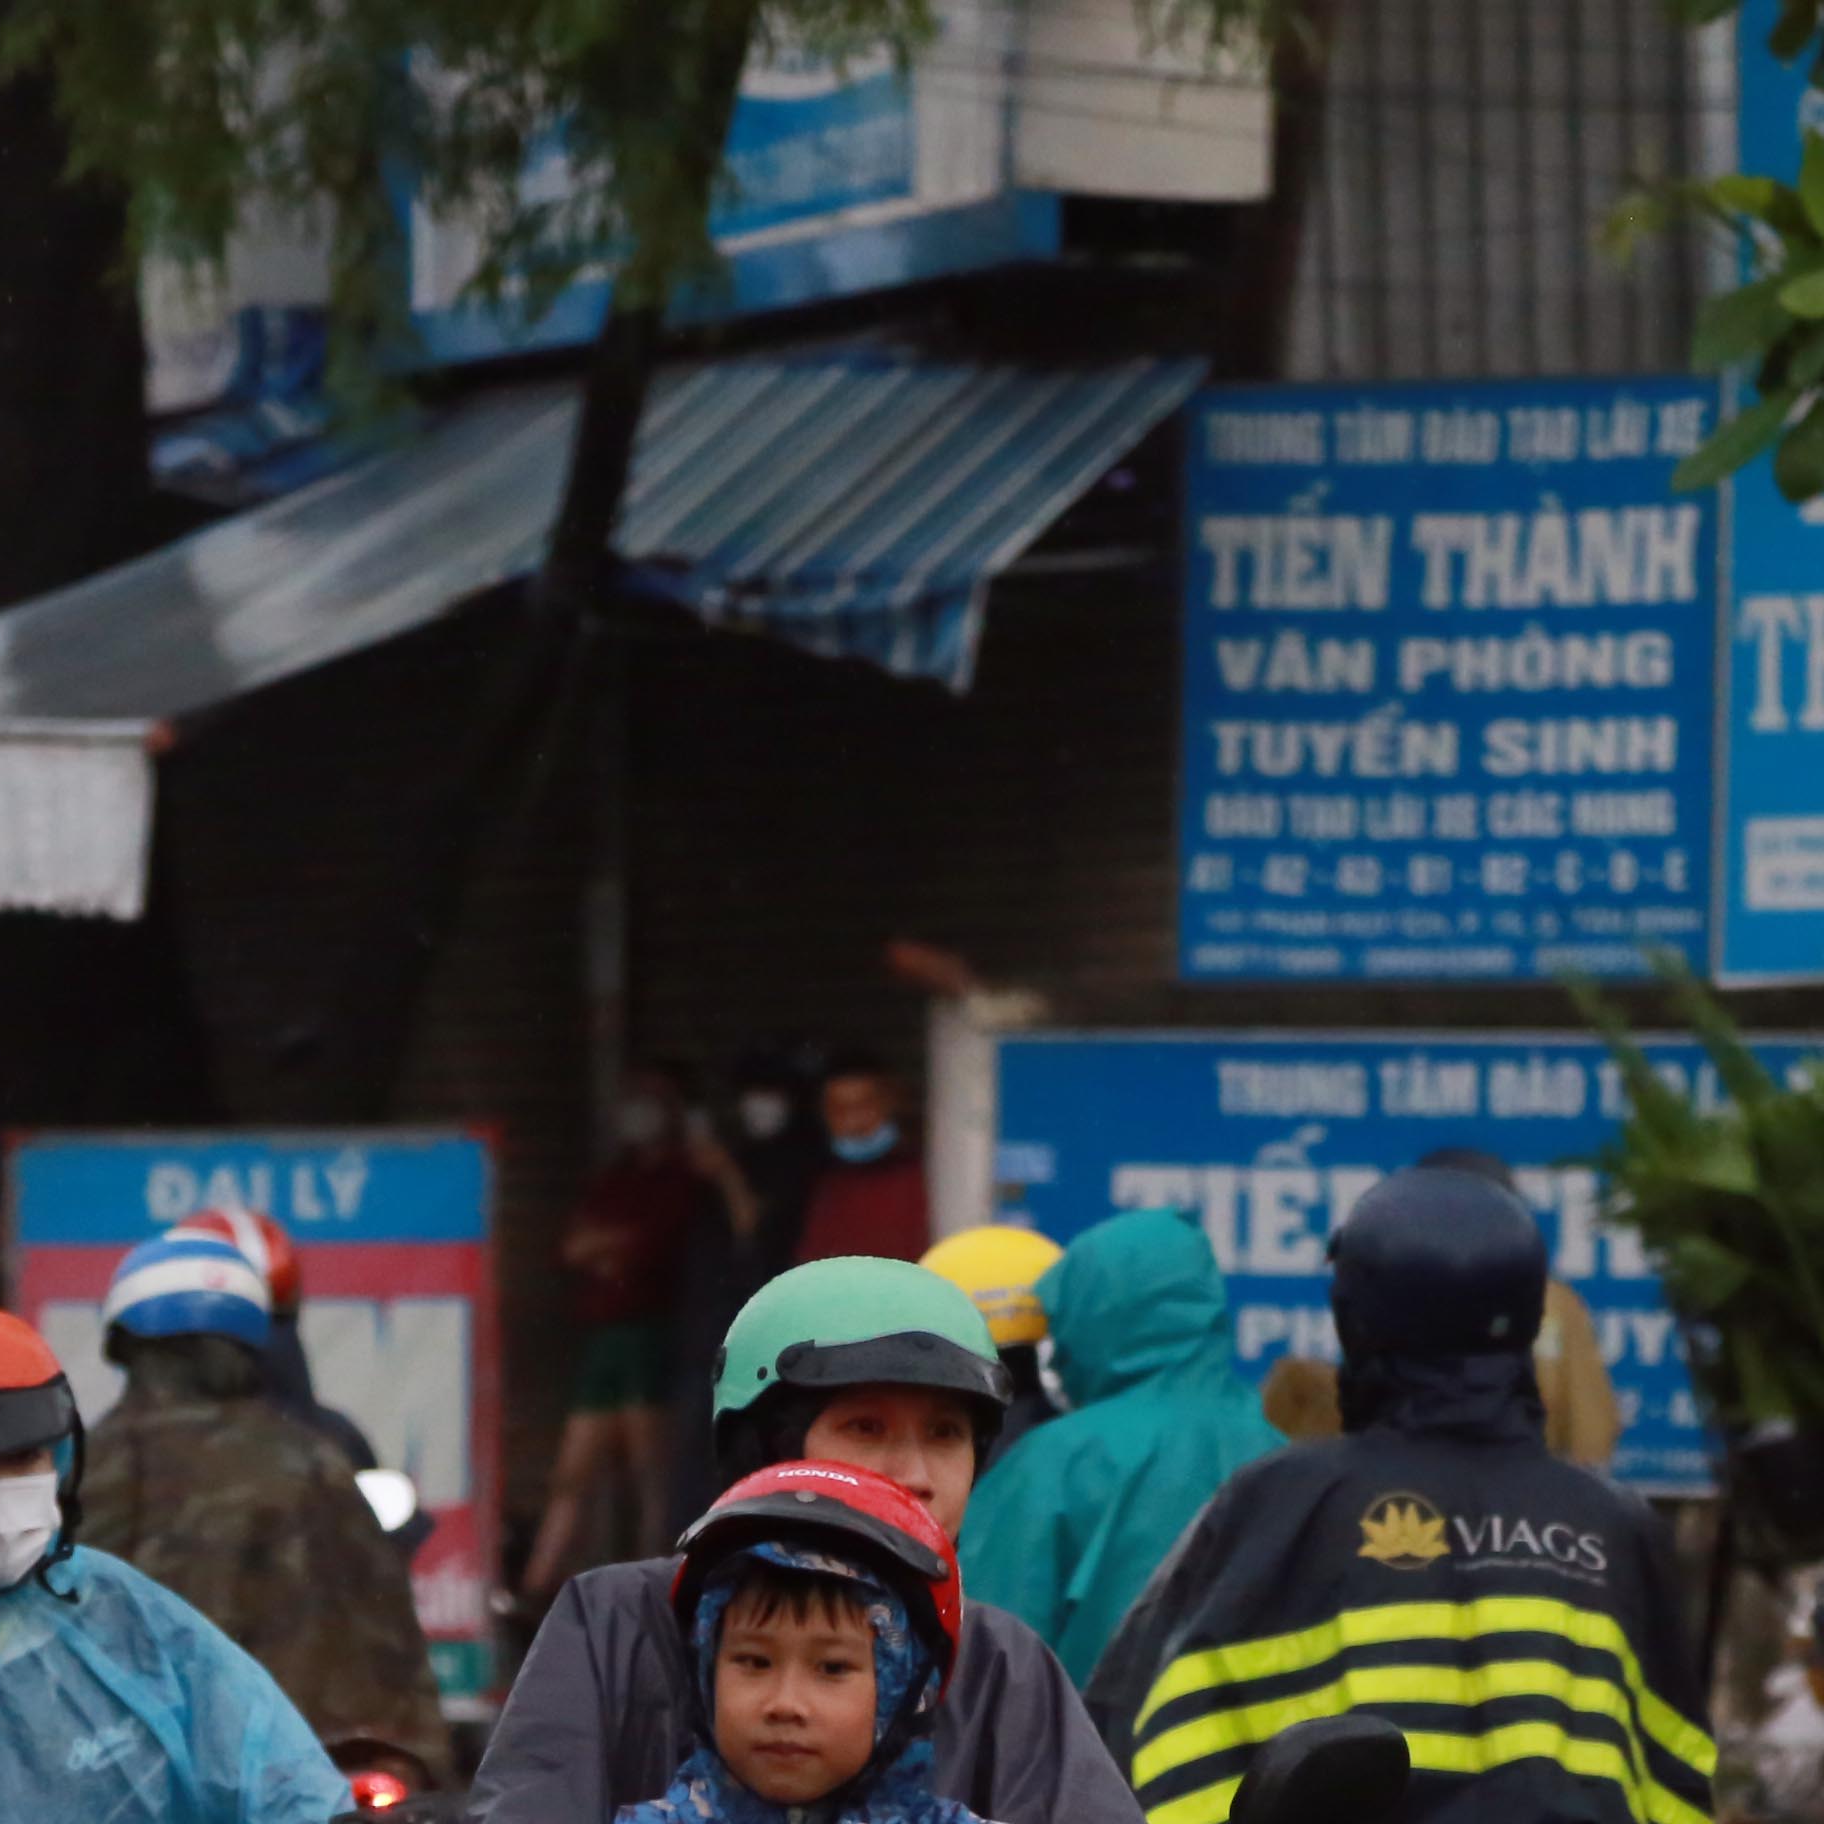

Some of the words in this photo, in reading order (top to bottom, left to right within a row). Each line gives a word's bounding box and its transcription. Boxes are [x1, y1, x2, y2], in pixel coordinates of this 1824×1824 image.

[1412, 494, 1700, 609] THÀNH
[1399, 622, 1675, 690] PHÒNG
[1482, 715, 1677, 776] SINH
[777, 1468, 859, 1486] HONDA
[1453, 1514, 1608, 1571] VIAGS
